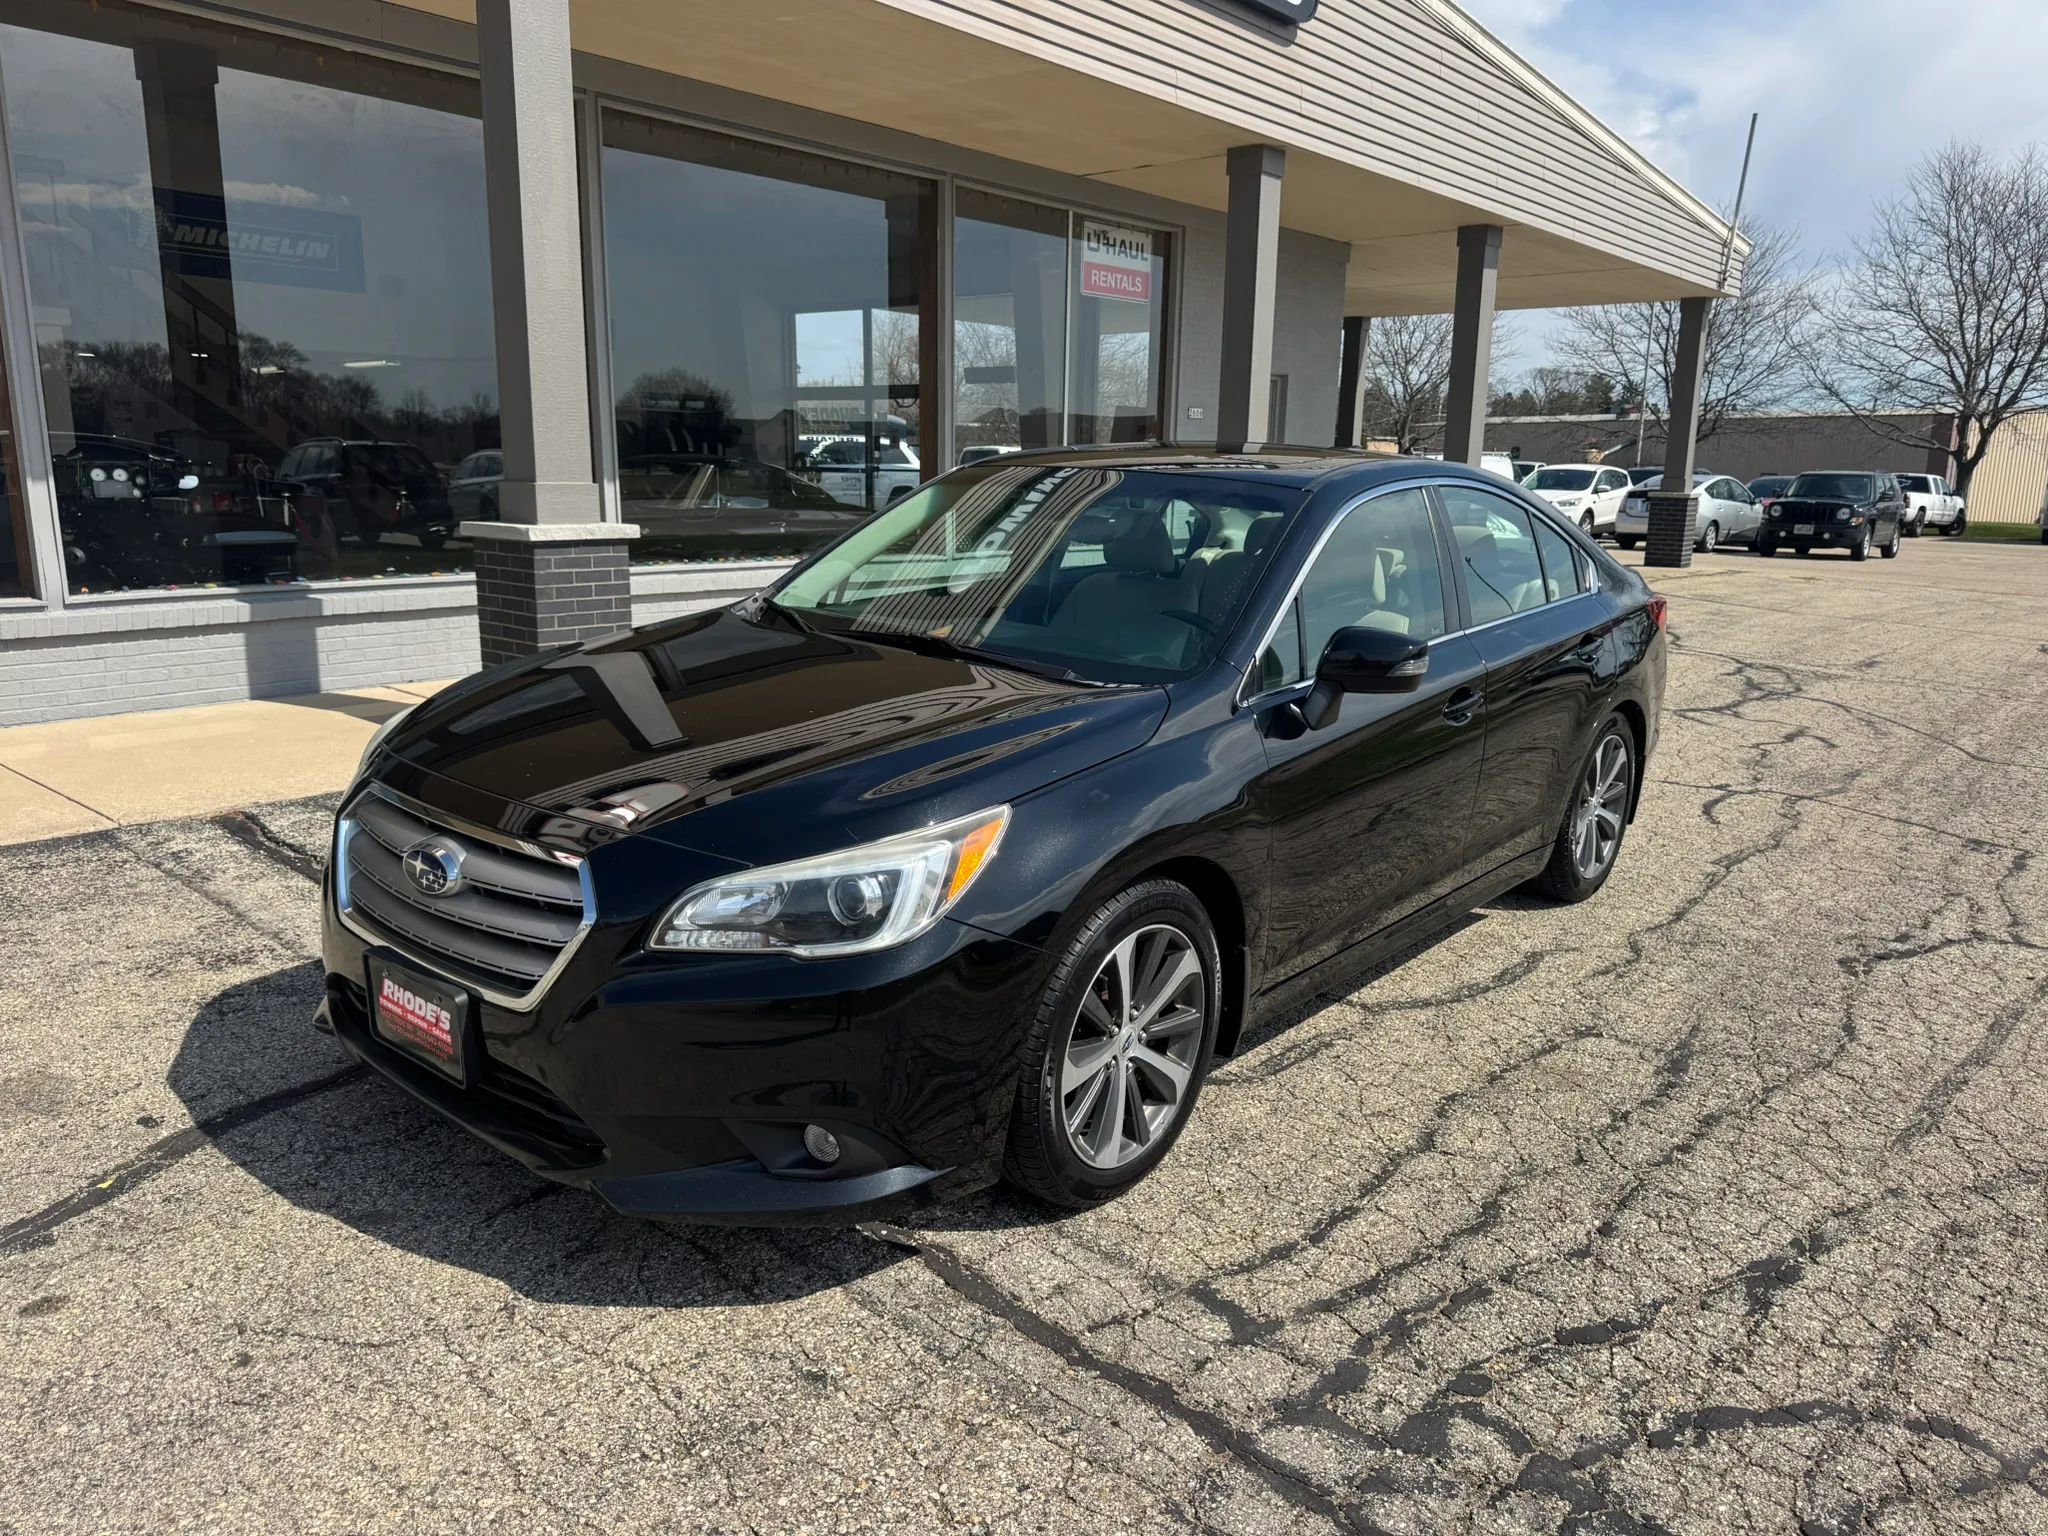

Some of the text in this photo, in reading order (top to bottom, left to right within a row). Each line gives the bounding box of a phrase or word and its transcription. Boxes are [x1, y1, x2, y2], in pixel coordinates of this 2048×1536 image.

[174, 224, 329, 259] MICHELIN
[1091, 270, 1143, 292] RENTALS
[382, 978, 451, 1031] RHODE'S
